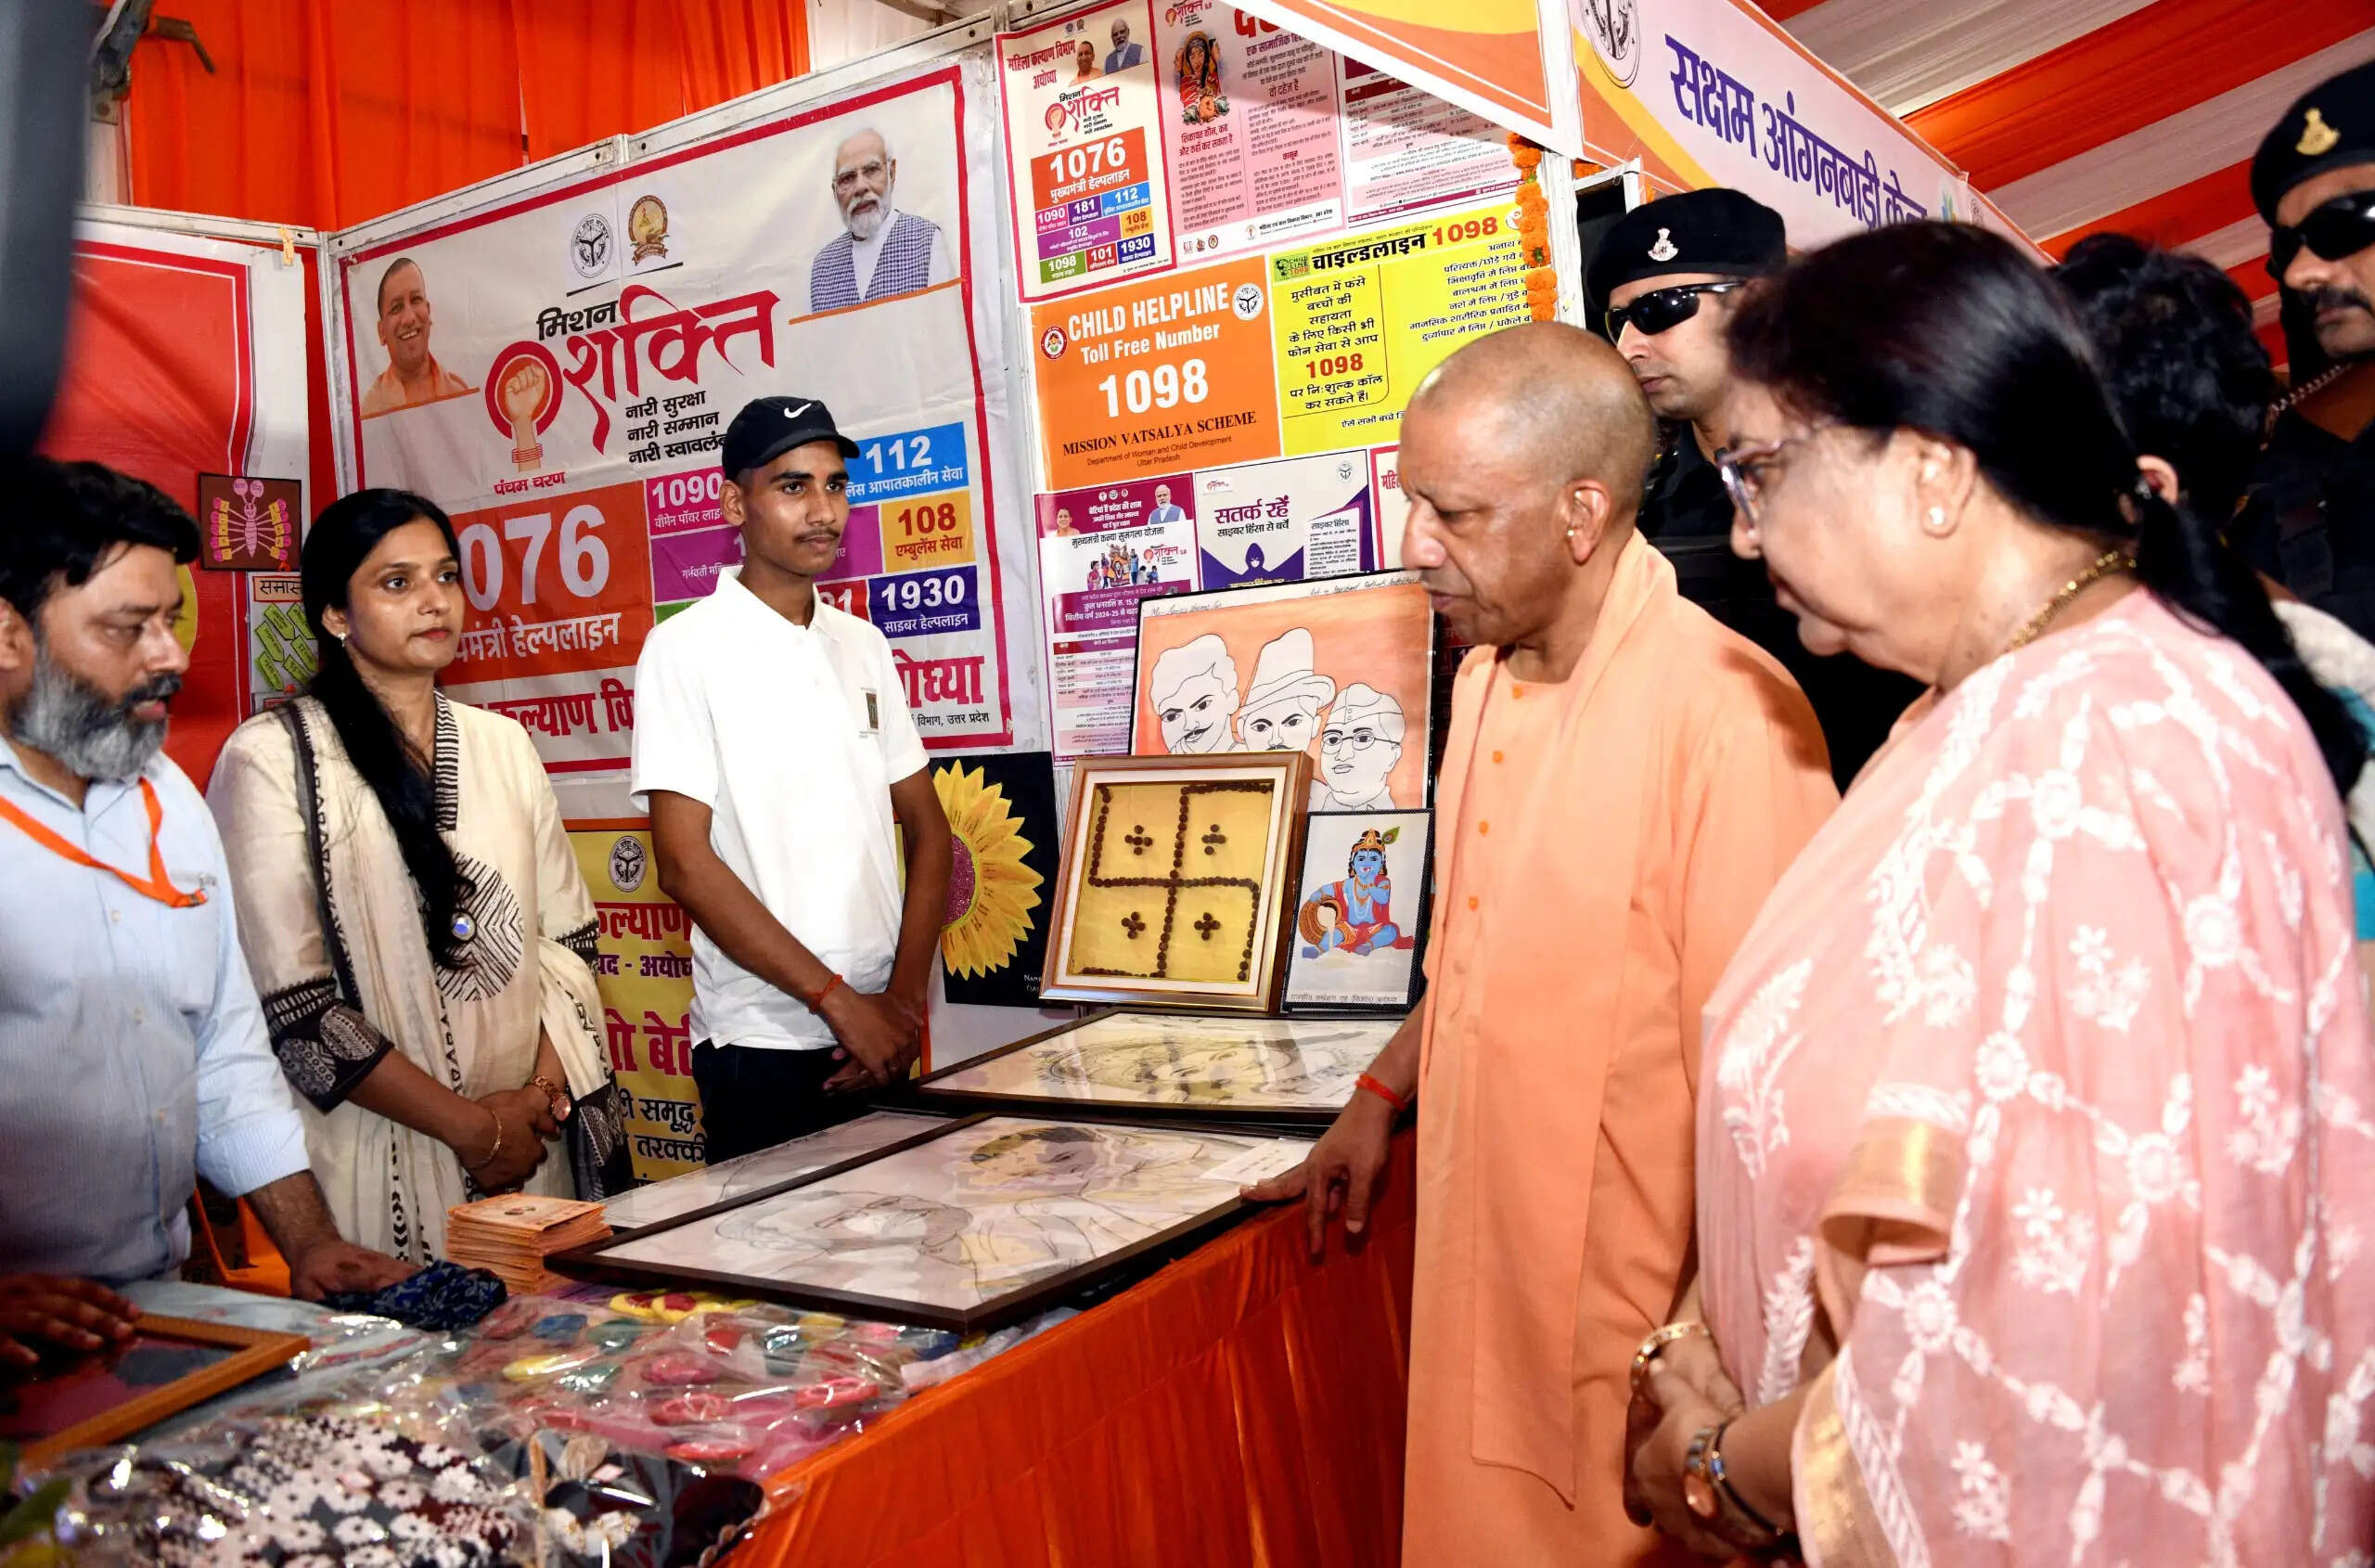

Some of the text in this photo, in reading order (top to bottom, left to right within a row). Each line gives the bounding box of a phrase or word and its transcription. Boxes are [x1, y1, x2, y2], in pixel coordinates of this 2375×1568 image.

[1664, 34, 1756, 158] सक्षम
[1050, 137, 1126, 184] 1076
[1050, 169, 1130, 203] मुख्यमंत्री हेल्पलाइन
[1115, 187, 1138, 203] 112
[1037, 208, 1066, 225] 1090
[1074, 199, 1095, 214] 181
[1126, 212, 1147, 225] 108
[1069, 225, 1088, 239] 102
[1121, 236, 1150, 254] 1930
[1312, 233, 1426, 270] चाइल्डलाइन
[1432, 216, 1498, 246] 1098
[1048, 255, 1076, 272] 1098
[1091, 247, 1112, 262] 101
[1290, 284, 1329, 303] मुसीबत
[1333, 279, 1342, 291] में
[1306, 293, 1352, 312] बच्चों की
[536, 300, 619, 341] मिशन
[1068, 282, 1229, 341] CHILD HELPLINE
[1309, 309, 1352, 325] सहायता
[1289, 317, 1375, 343] के लिए किसी भी
[1081, 323, 1220, 365] Toll Free Number
[1288, 334, 1379, 357] फोन सेवा से आप
[563, 284, 780, 456] शक्ति
[1306, 353, 1364, 379] 1098
[1098, 358, 1209, 418] 1098
[1290, 387, 1303, 399] पर
[1357, 374, 1383, 389] कॉल
[625, 390, 706, 419] नारी सुरक्षा
[1305, 398, 1321, 410] कर
[1326, 394, 1354, 407] सकते
[627, 411, 720, 443] नारी सम्मान
[1063, 411, 1257, 456] MISSION VATSALYA SCHEME
[628, 431, 726, 465] नारी स्वावलं
[867, 435, 932, 474] 112
[1157, 444, 1169, 455] and
[1170, 441, 1188, 453] Child
[494, 471, 566, 496] पंचम चरण
[652, 472, 724, 508] 1090
[869, 469, 939, 495] आपातकालीन
[942, 465, 964, 482] सेवा
[1381, 469, 1400, 490] महि
[678, 508, 700, 524] पॉवर
[702, 508, 722, 520] लाइ
[898, 502, 956, 536] 108
[1214, 495, 1290, 524] सतर्क रहें
[1144, 526, 1164, 537] योजना
[1217, 527, 1244, 537] साइबर
[1245, 522, 1265, 534] हिंसा
[1266, 521, 1274, 531] से
[458, 504, 610, 611] 076
[895, 534, 964, 560] एम्बुलेंस सेवा
[881, 574, 966, 611] 1930
[509, 612, 622, 659] हेल्पलाइन
[884, 612, 969, 634] साइबर हेल्पलाइन
[947, 713, 966, 726] उत्तर
[969, 709, 990, 724] प्रदेश
